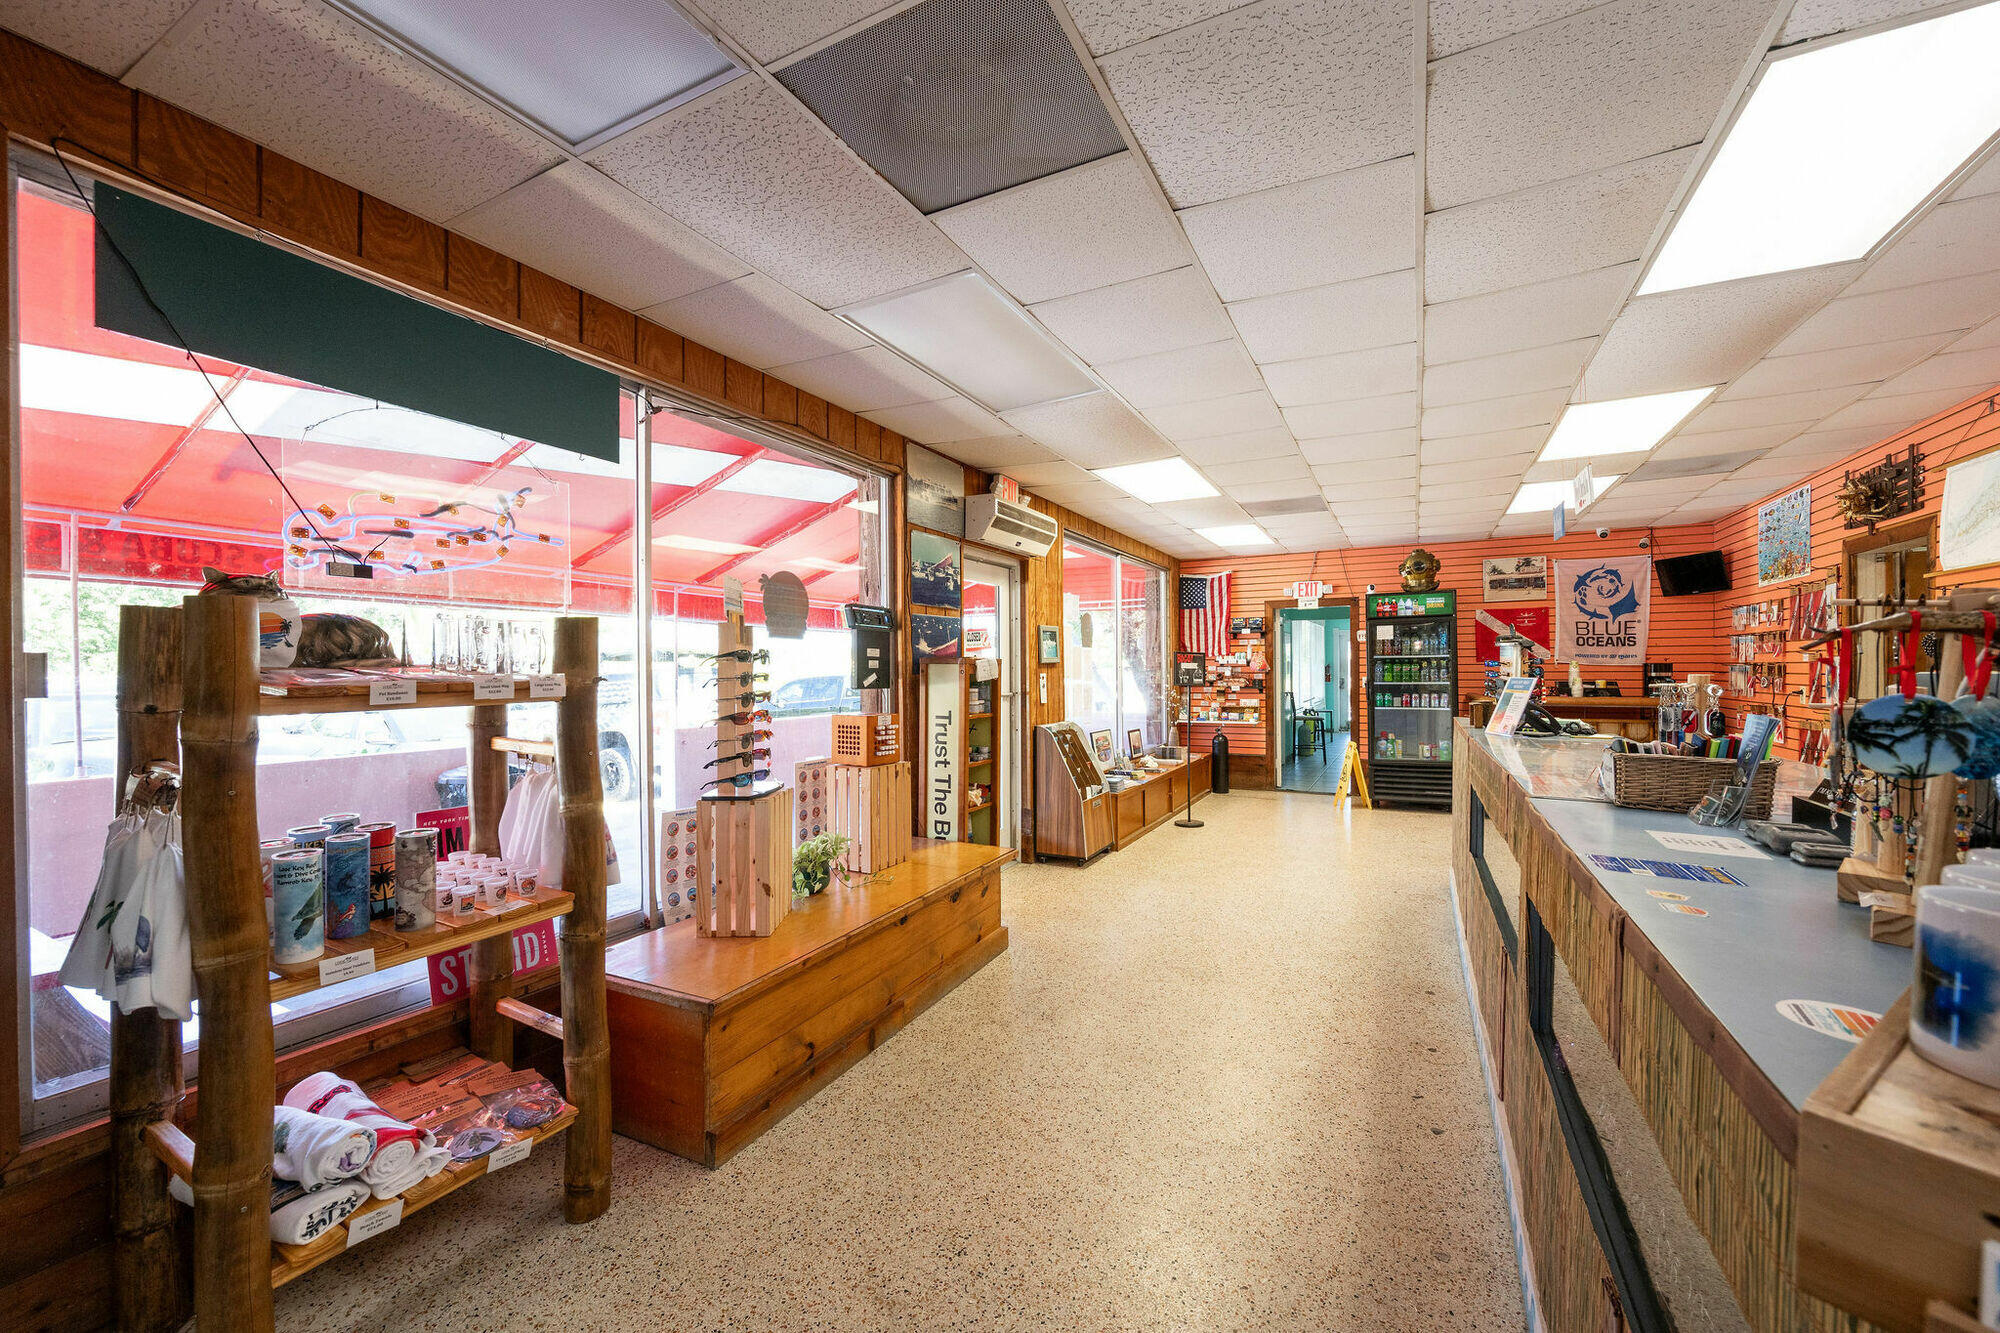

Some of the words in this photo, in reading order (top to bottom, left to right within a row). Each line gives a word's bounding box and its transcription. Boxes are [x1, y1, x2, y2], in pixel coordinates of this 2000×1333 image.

[1298, 582, 1318, 597] EXIT
[1575, 620, 1637, 635] BLUE
[1576, 636, 1637, 647] OCEANS
[934, 710, 952, 768] Trust
[934, 774, 952, 816] The
[437, 827, 464, 858] IM
[440, 932, 540, 996] STID
